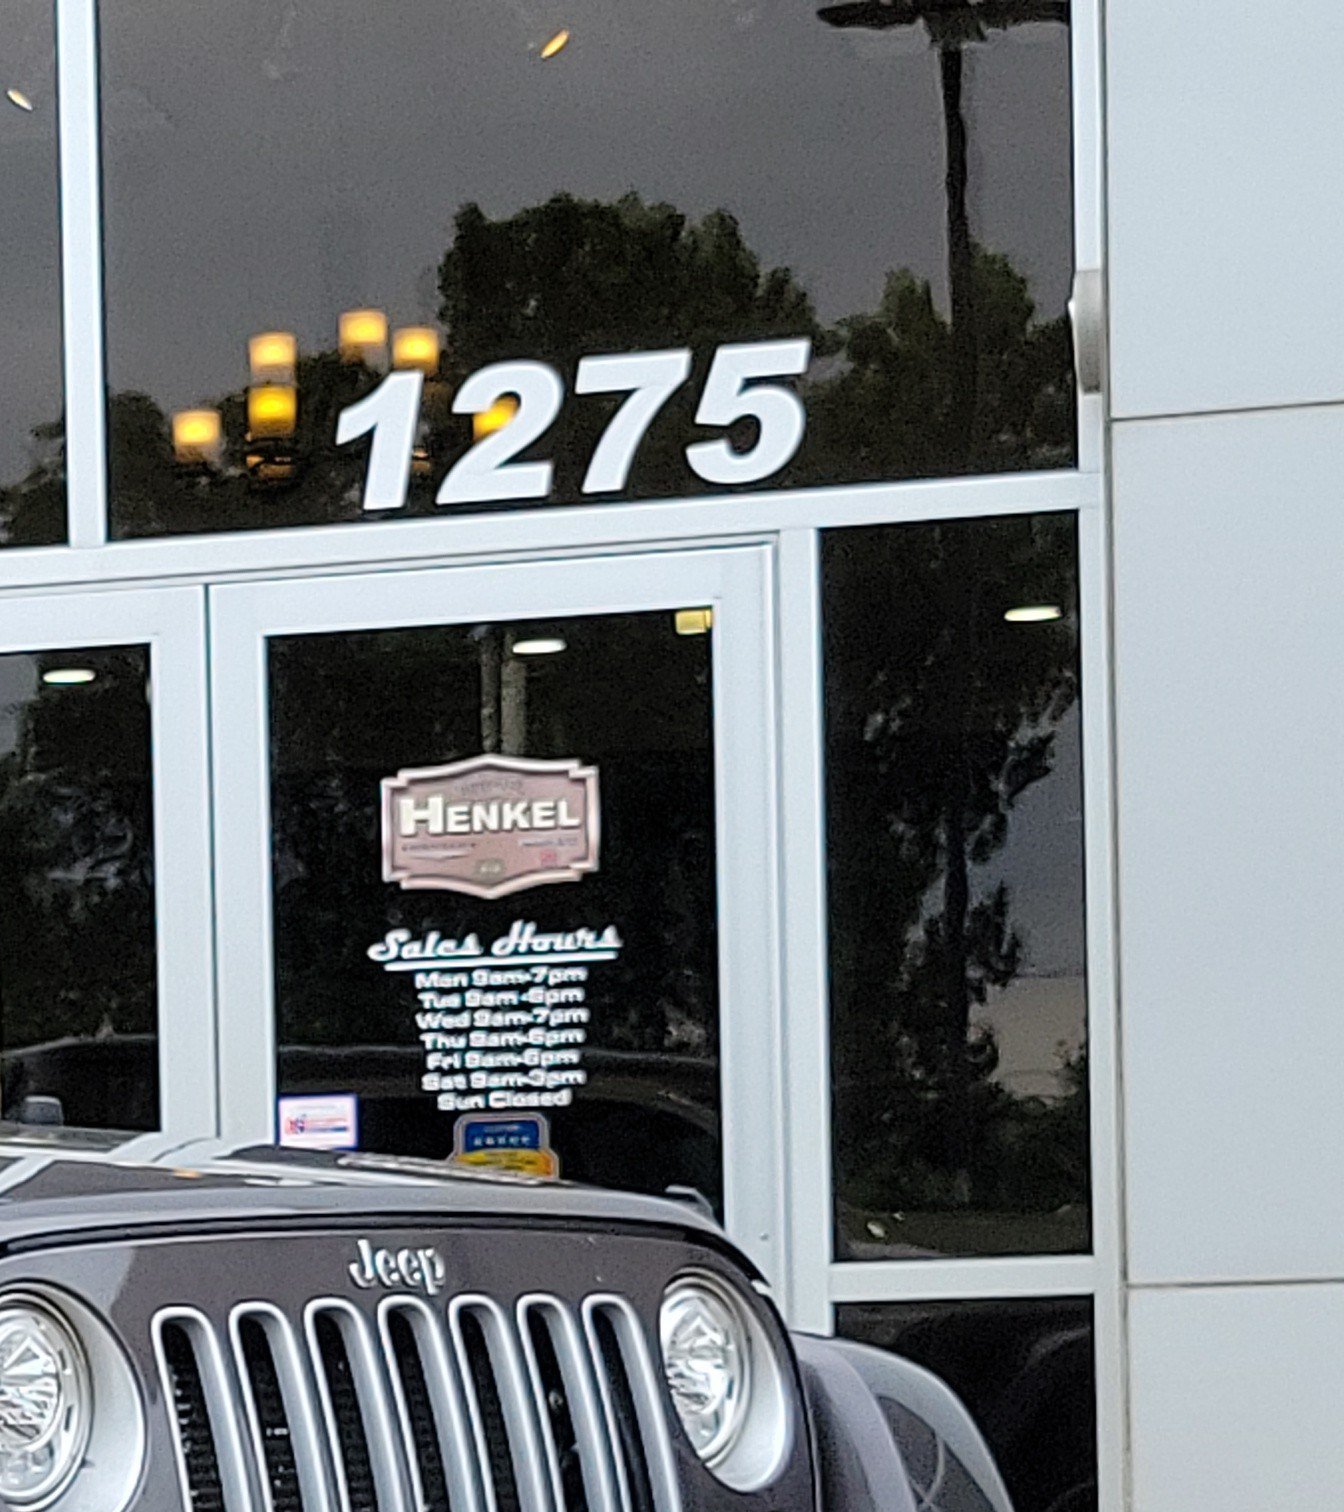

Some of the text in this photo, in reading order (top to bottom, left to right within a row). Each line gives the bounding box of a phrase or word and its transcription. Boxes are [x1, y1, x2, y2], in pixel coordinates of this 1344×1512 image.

[335, 337, 811, 512] 1275
[399, 795, 582, 837] HENKEL
[367, 919, 623, 961] Sales Hours
[415, 972, 468, 989] Mon
[415, 1010, 472, 1029] Wed
[419, 1031, 467, 1050] Thu
[426, 1052, 461, 1070] Fri
[421, 1072, 467, 1091] Sat
[437, 1088, 573, 1110] Sun Closed
[348, 1238, 446, 1295] Jeep
